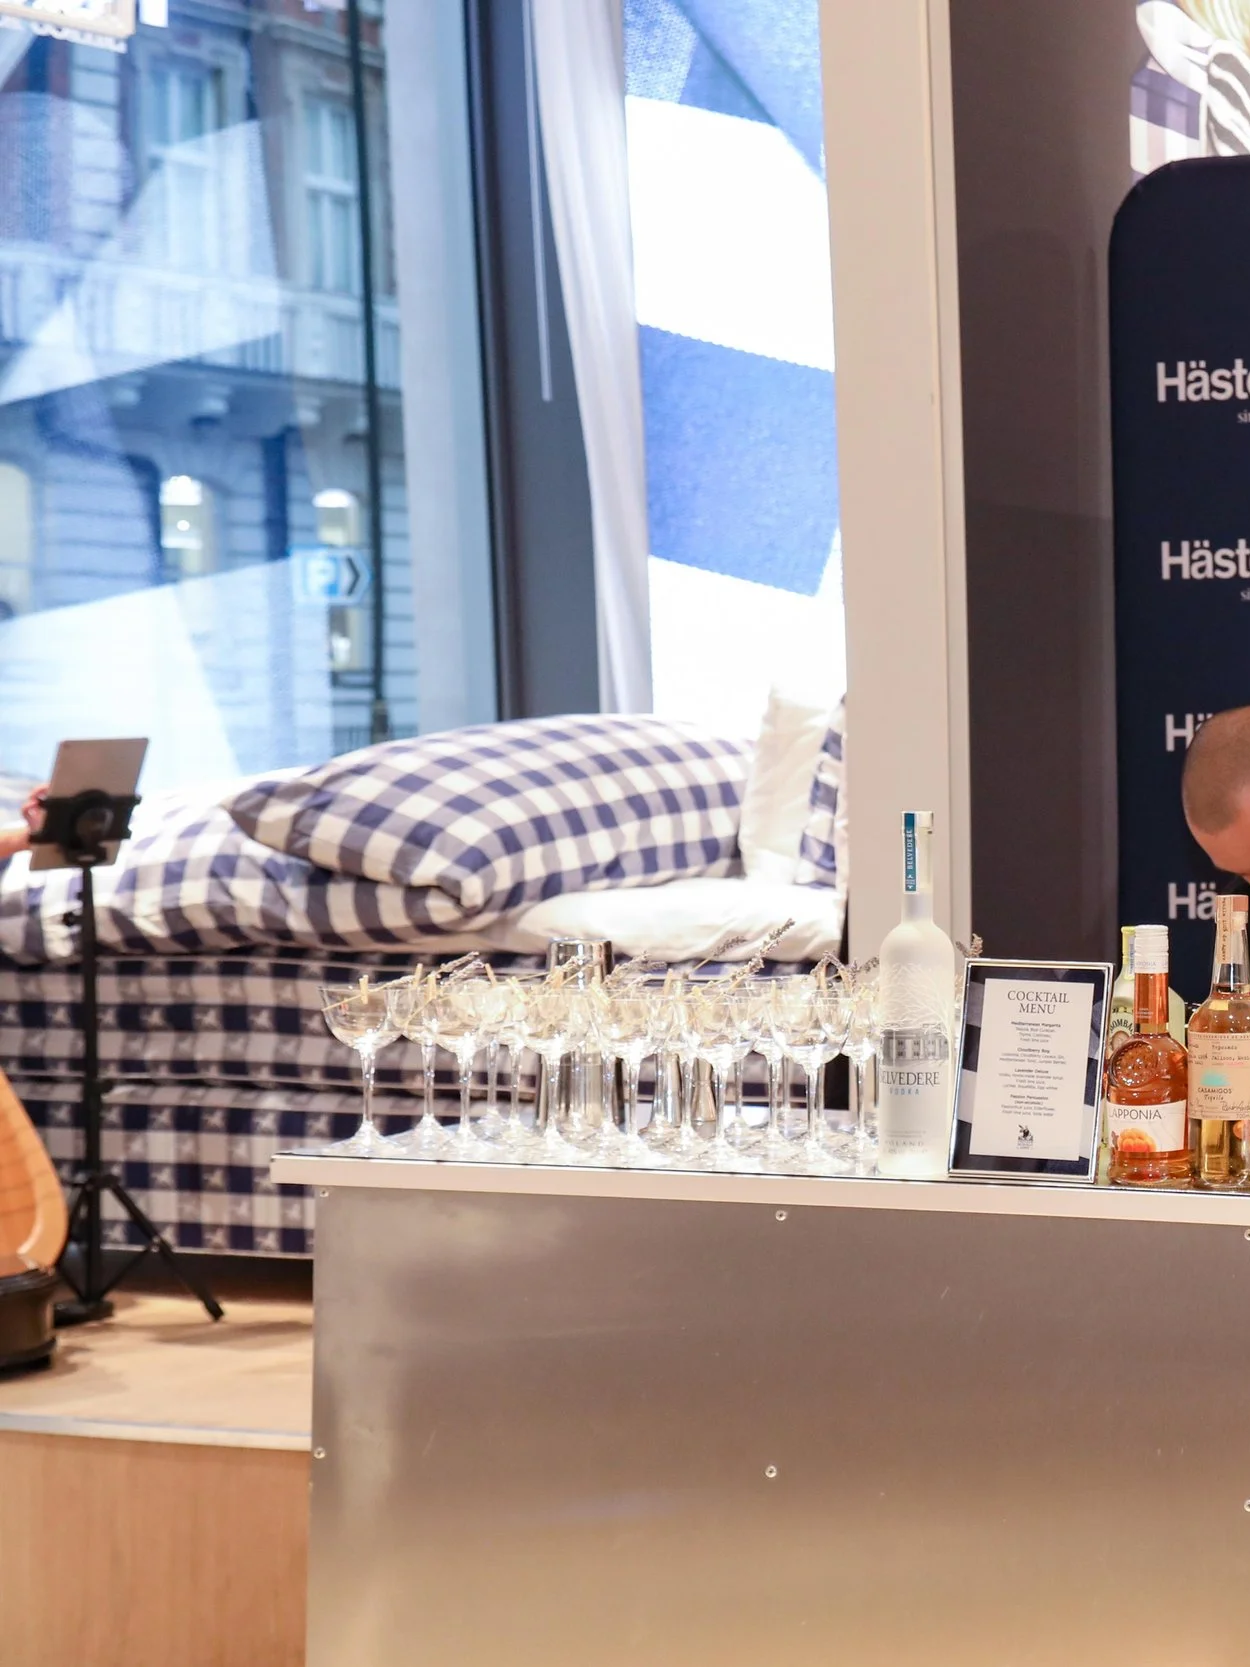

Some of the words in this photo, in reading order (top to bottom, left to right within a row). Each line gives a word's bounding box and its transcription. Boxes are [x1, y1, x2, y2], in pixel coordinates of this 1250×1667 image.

[905, 828, 914, 870] BELVEDERE
[1007, 990, 1069, 1003] COCKTAIL
[1019, 1003, 1056, 1014] MENU
